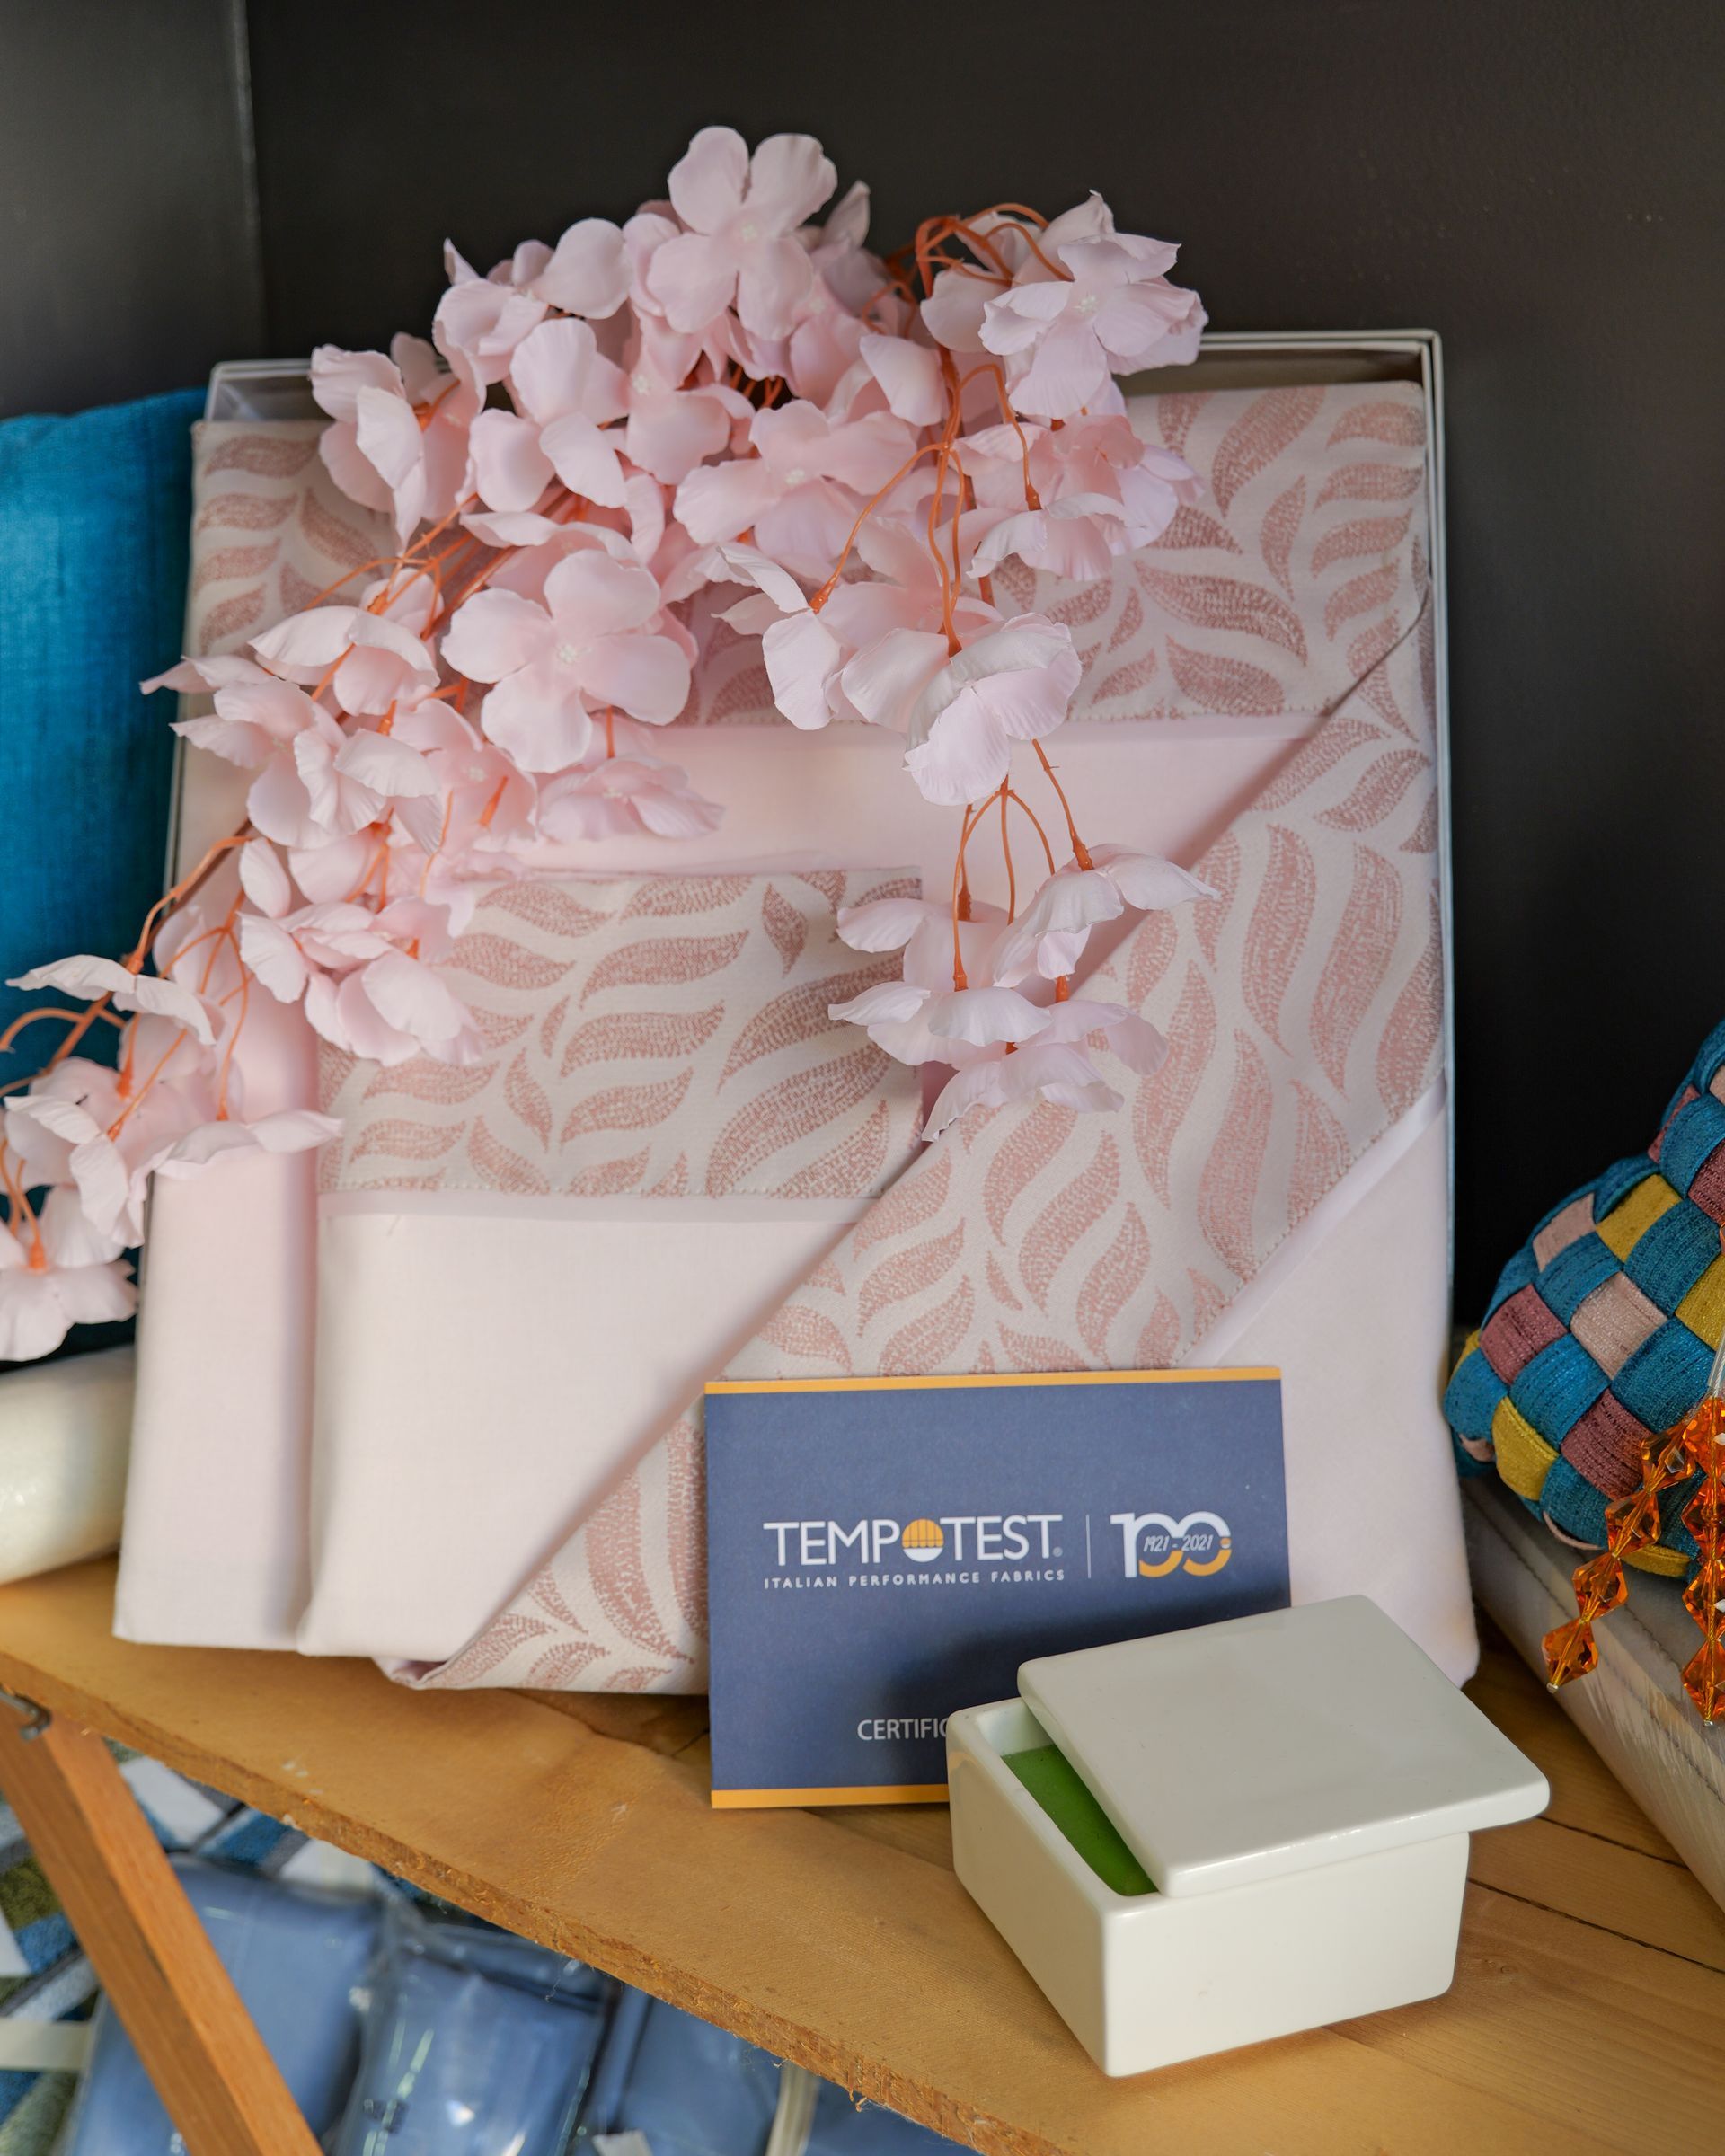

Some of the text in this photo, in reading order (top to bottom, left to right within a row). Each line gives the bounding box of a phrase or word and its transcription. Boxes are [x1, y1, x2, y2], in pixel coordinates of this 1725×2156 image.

[1143, 1535, 1170, 1552] 1921
[1181, 1534, 1213, 1551] 2021
[764, 1569, 1065, 1589] ITALIAN PERFORMANCE FABRICS
